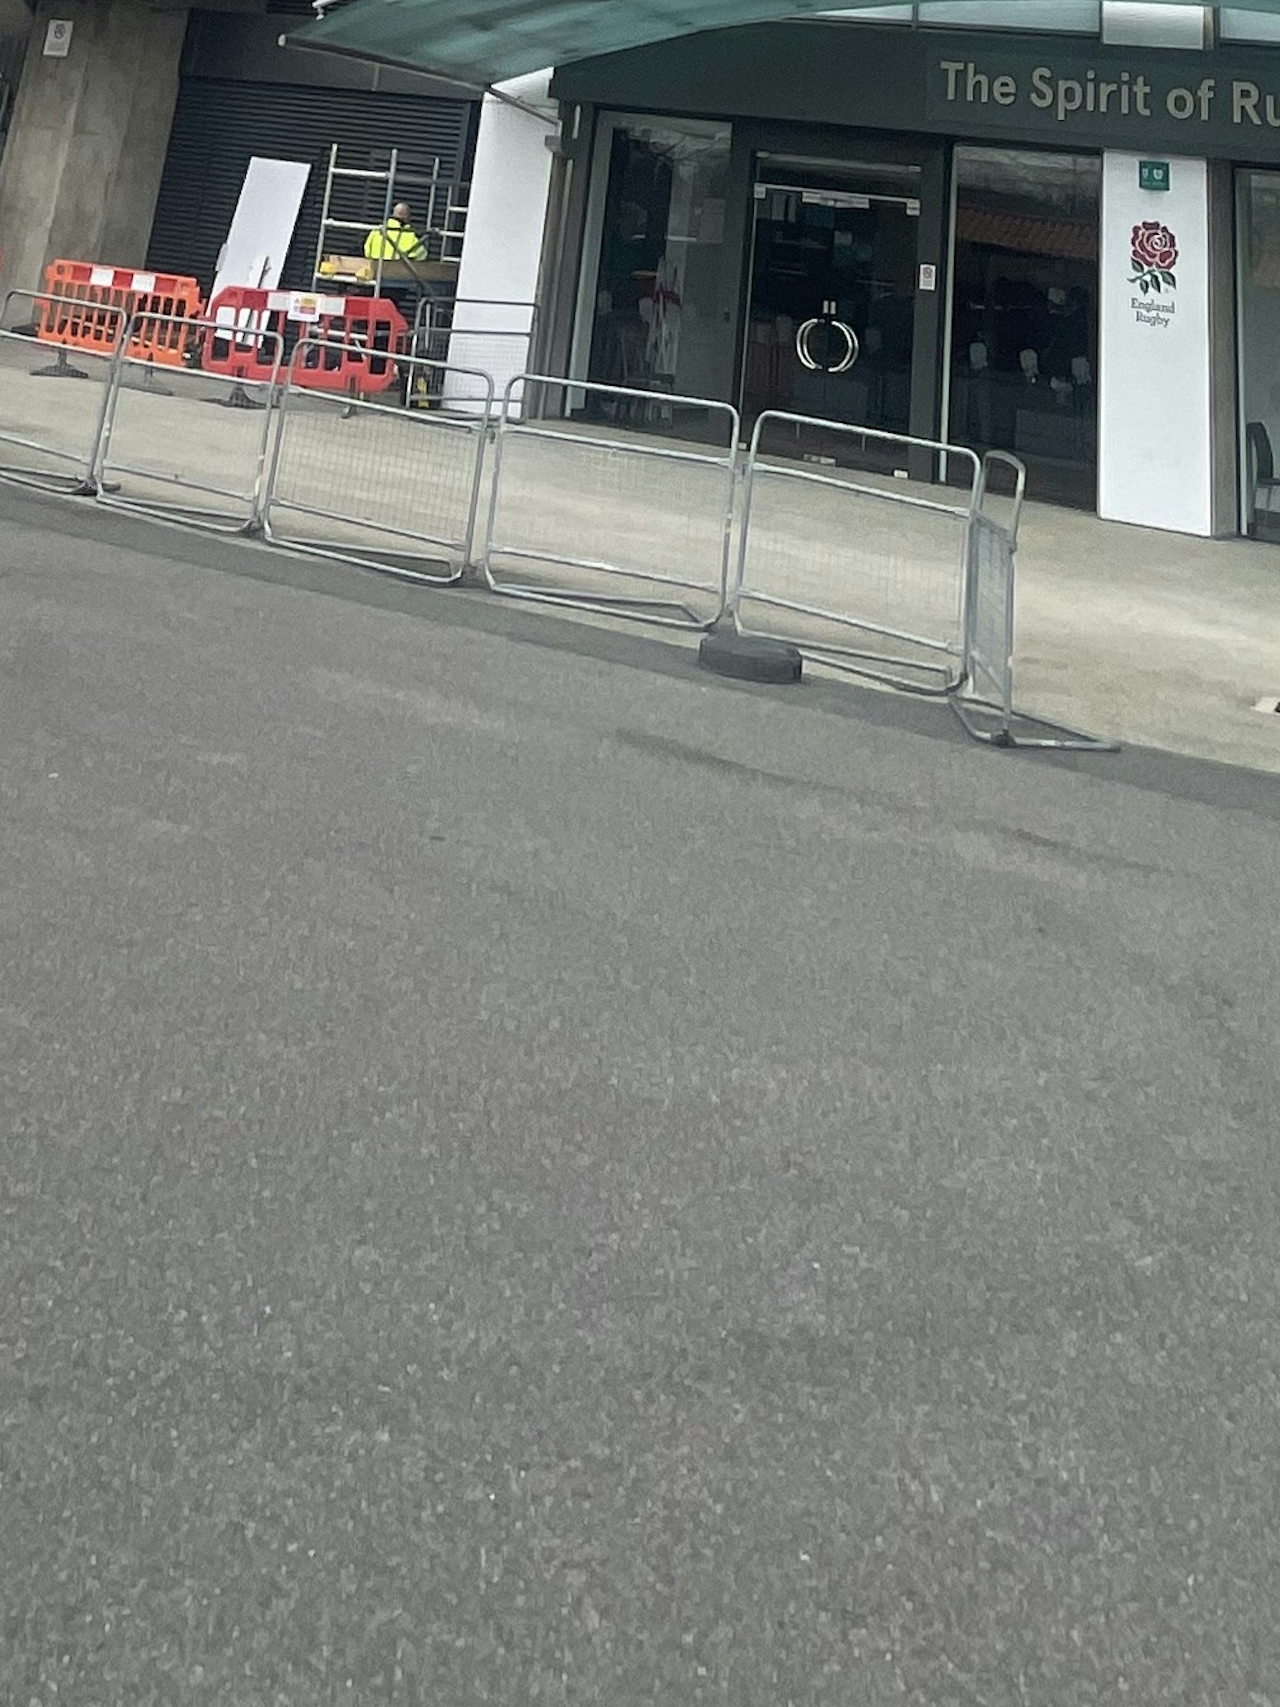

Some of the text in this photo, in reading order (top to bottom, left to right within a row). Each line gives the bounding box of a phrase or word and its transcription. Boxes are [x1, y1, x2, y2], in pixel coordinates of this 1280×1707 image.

[940, 61, 1017, 105] The
[1030, 67, 1152, 121] Spirit
[1166, 78, 1215, 121] of
[1131, 297, 1175, 314] England
[1136, 309, 1170, 327] Rugby
